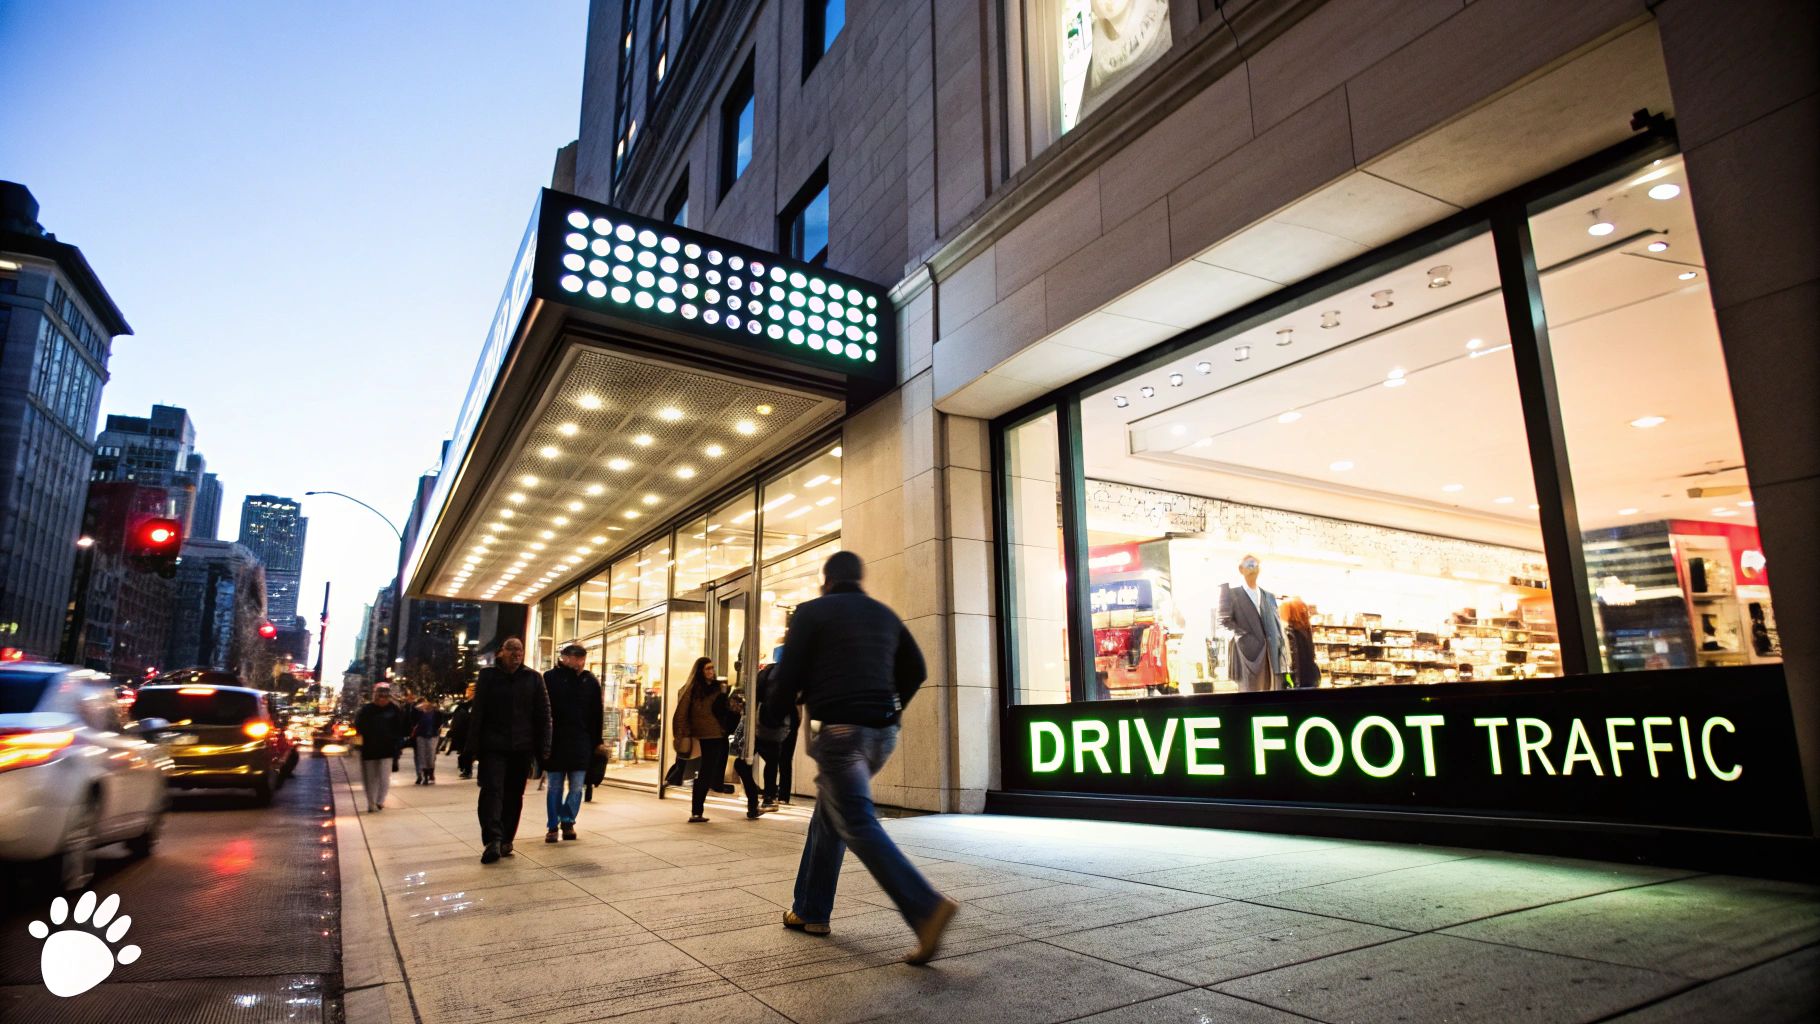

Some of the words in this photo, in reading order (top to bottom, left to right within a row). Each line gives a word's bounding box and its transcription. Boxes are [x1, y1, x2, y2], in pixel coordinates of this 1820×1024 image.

[1029, 716, 1225, 776] DRIVE
[1251, 715, 1445, 777] FOOT
[1473, 716, 1743, 782] TRAFFIC
